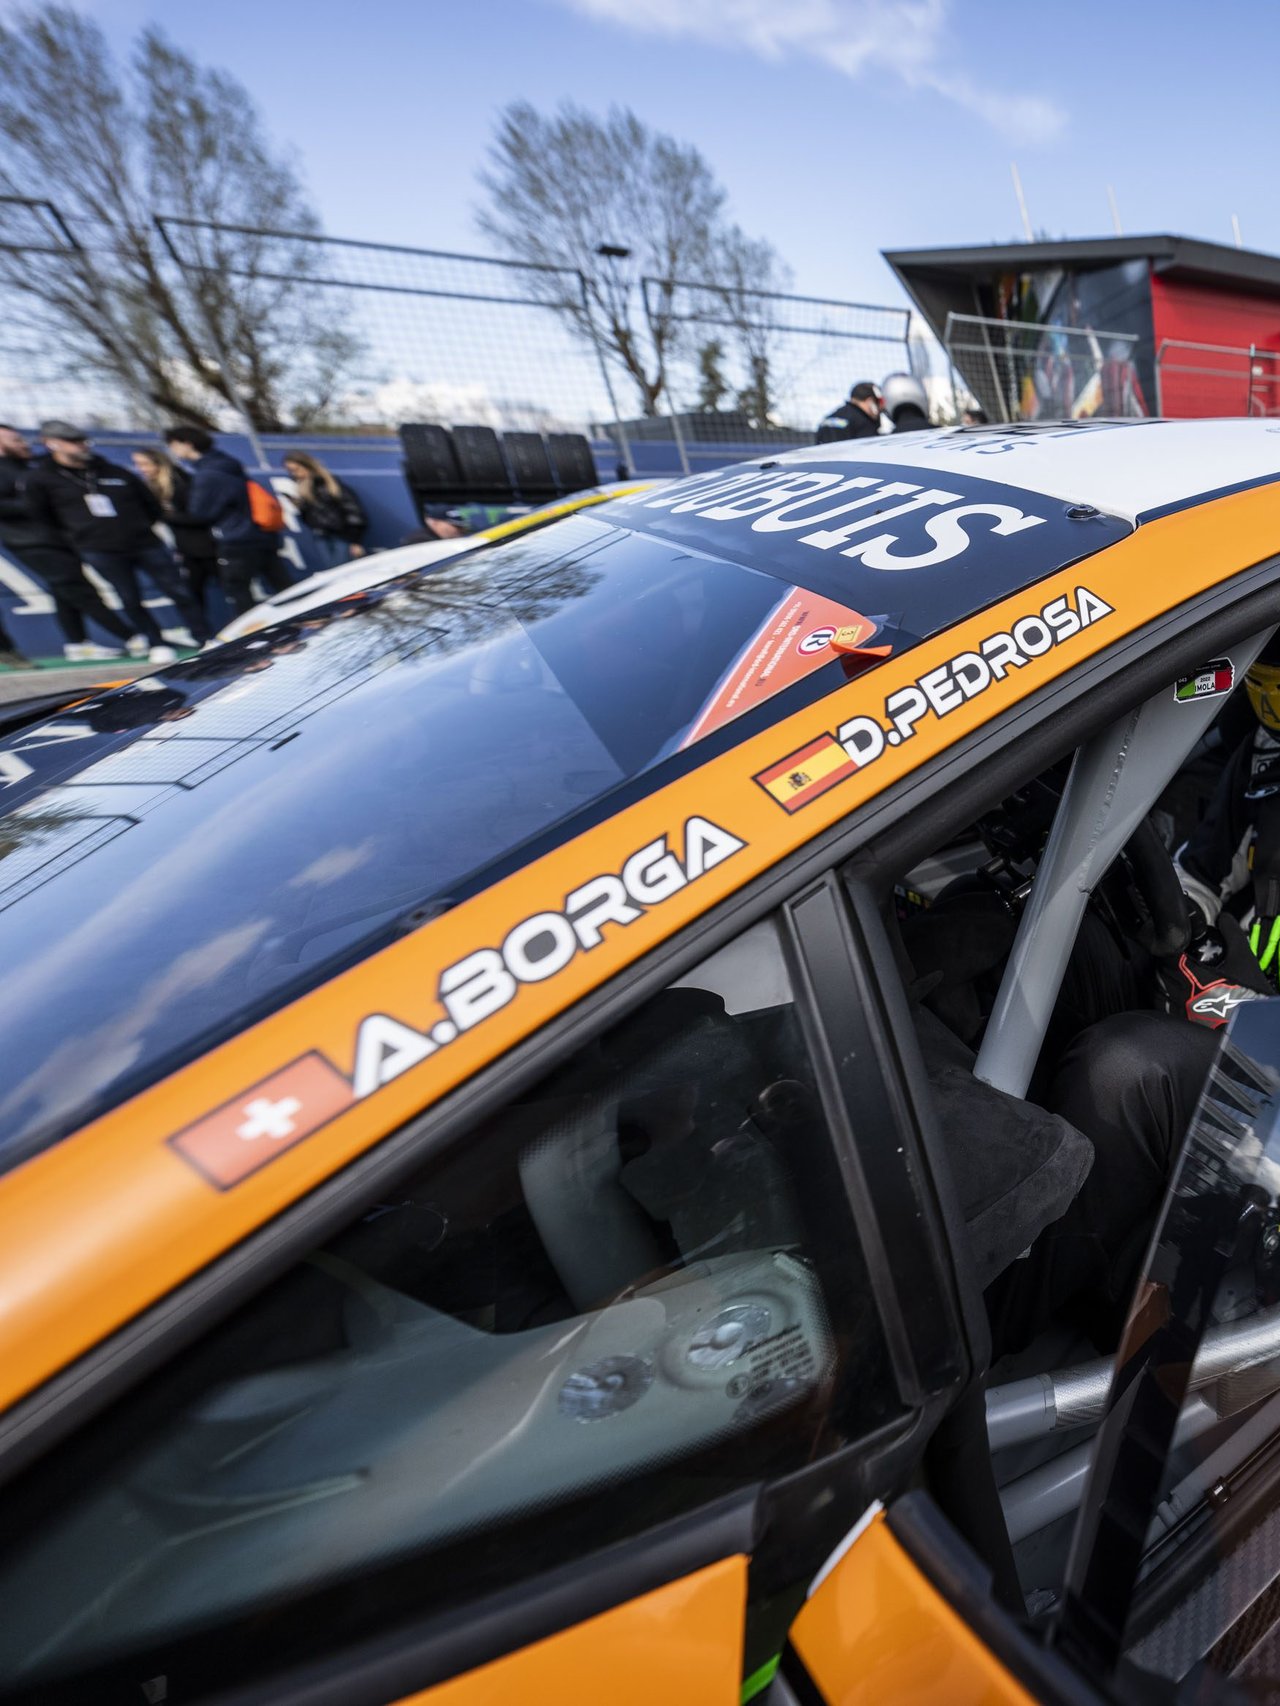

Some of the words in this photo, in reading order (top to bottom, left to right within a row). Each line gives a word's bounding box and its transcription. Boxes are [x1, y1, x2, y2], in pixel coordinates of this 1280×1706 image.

[643, 472, 1048, 571] DUBUIS
[837, 586, 1116, 768] D.PEDROSA
[354, 815, 749, 1099] A.BORGA
